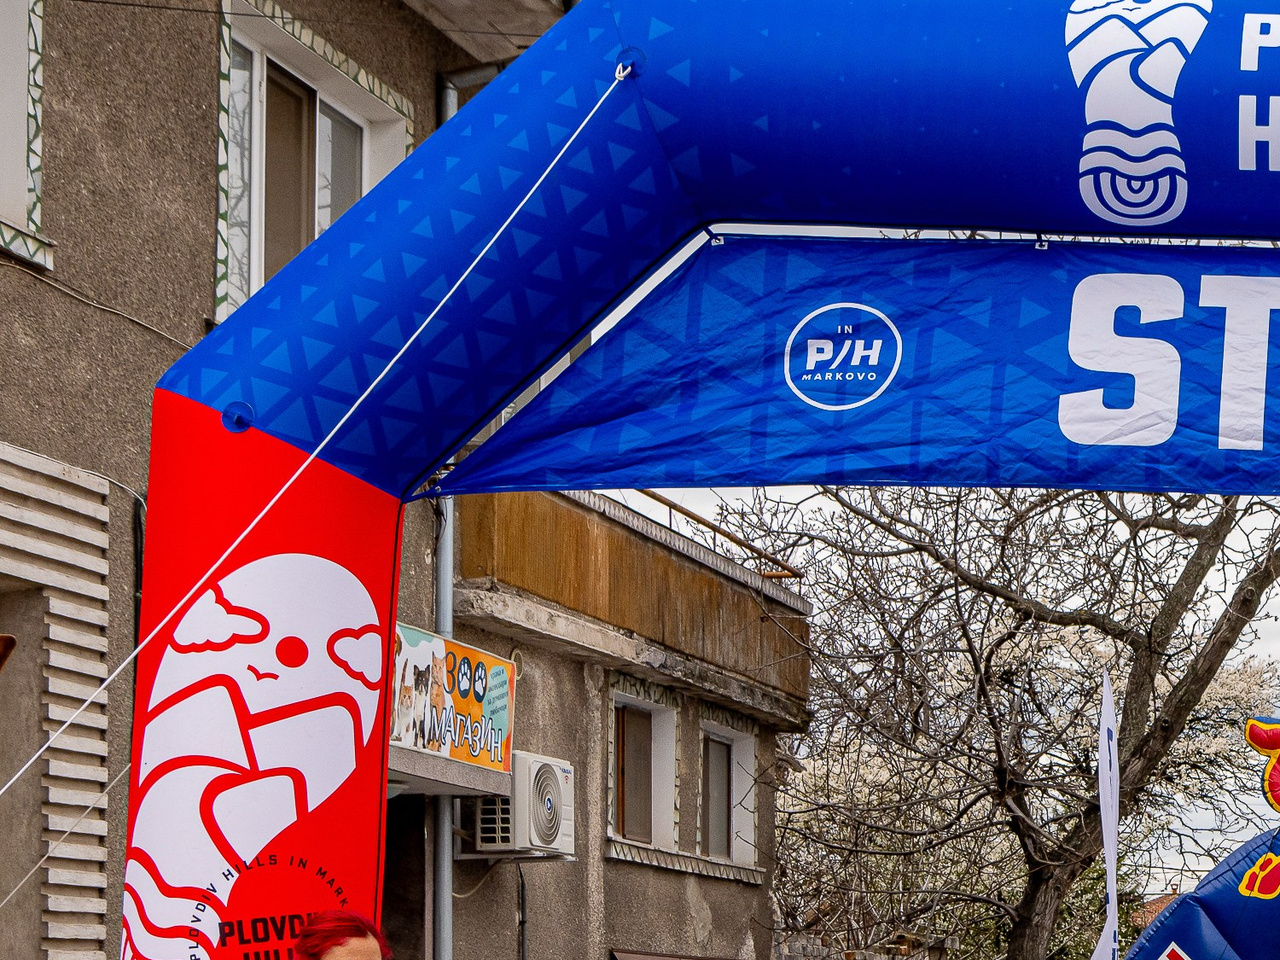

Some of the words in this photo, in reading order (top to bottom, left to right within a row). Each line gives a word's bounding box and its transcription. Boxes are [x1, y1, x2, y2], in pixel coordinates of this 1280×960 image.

[837, 325, 853, 334] IN
[805, 339, 883, 371] P/H
[801, 372, 877, 381] MARKOVO
[430, 705, 503, 762] МАГАЗИН
[222, 854, 278, 882] HILLS
[289, 855, 309, 870] IN
